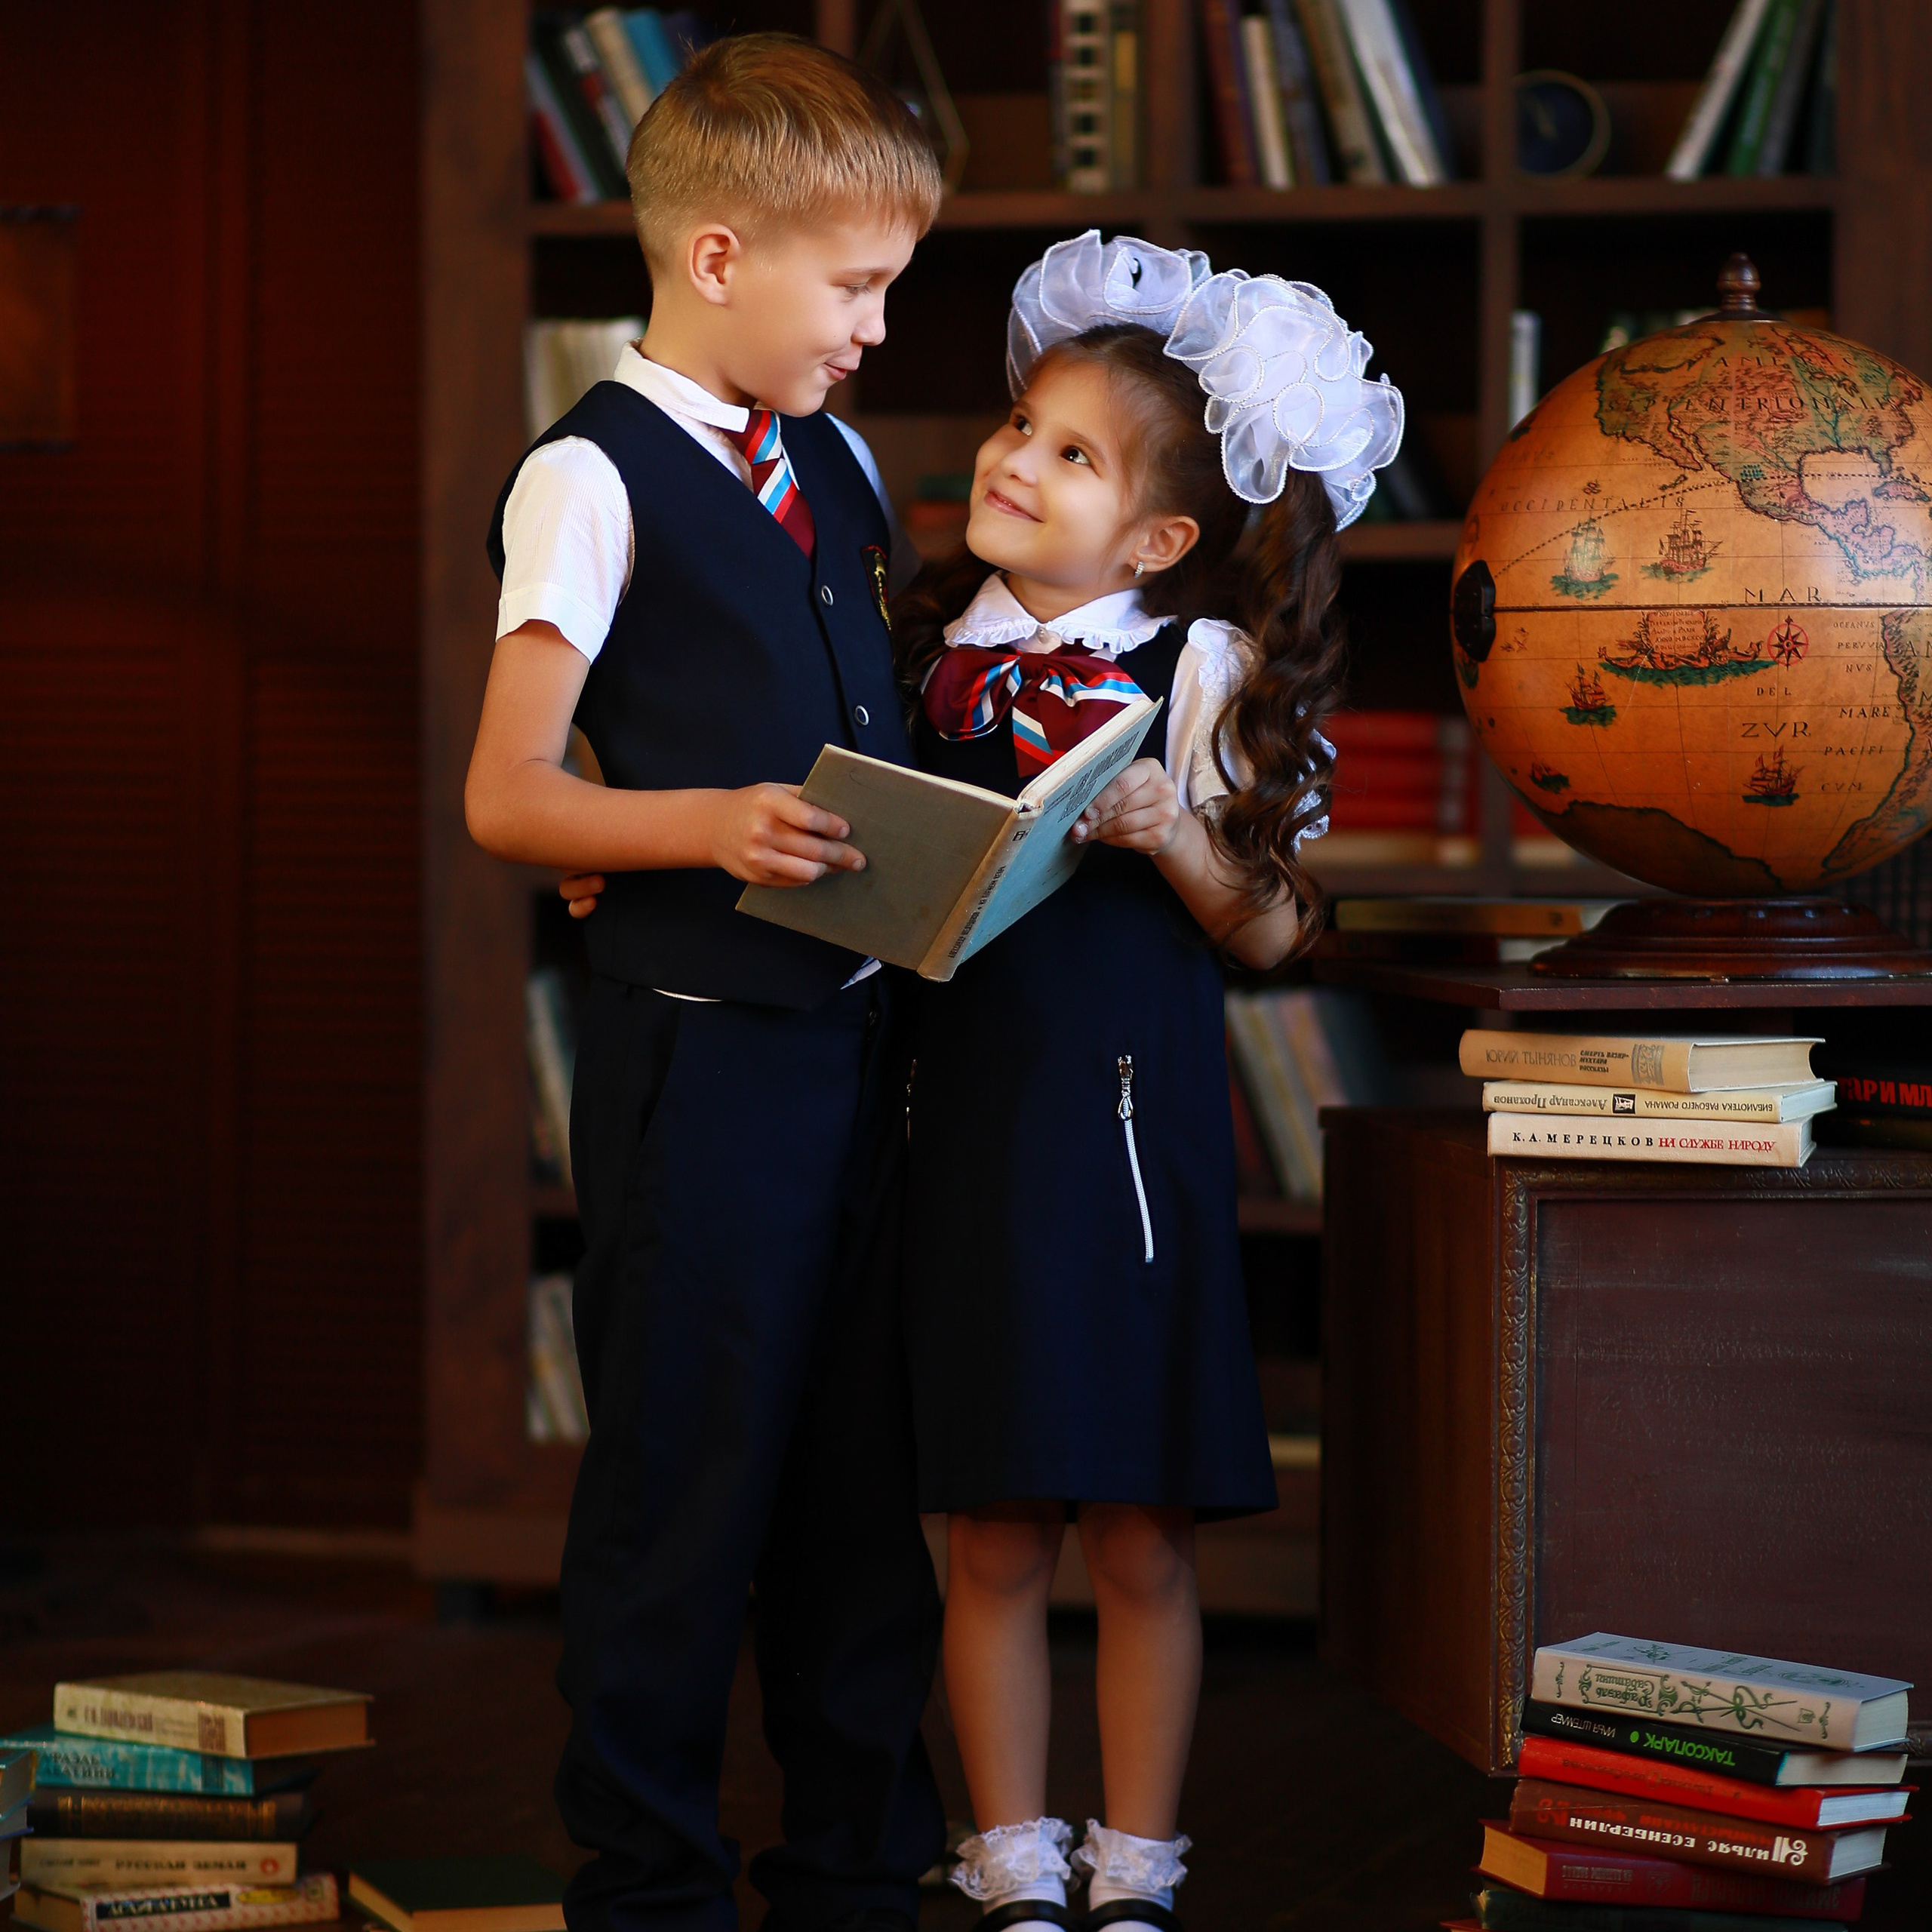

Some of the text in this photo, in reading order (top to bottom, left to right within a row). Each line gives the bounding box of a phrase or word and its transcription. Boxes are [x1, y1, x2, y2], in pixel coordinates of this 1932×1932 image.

[1500, 495, 1686, 512] OCCIDENTALIS
[1743, 586, 1823, 602] MAR
[1756, 686, 1792, 697] DEL
[1838, 706, 1890, 718] MARE
[1740, 721, 1811, 738] ZVR
[1485, 1049, 1577, 1067] ЮРИЙ ТЫНЯНОВ
[1494, 1094, 1608, 1110] Александр Проханов
[1644, 1100, 1773, 1112] БИБЛИОТЕКА РАБОЧЕГО РОМАНА
[1512, 1132, 1777, 1153] К. А. МЕРЕЦКОВ НА СЛУЖБЕ НАРОДУ
[1595, 1673, 1655, 1696] Сабатини
[1595, 1687, 1653, 1709] Рафаэль
[1592, 1724, 1617, 1737] ИЛЬЯ
[1643, 1732, 1736, 1766] ТАКСОПАРК
[1570, 1817, 1770, 1861] ИЛЬЯС ЕСЕНБЕРЛИН
